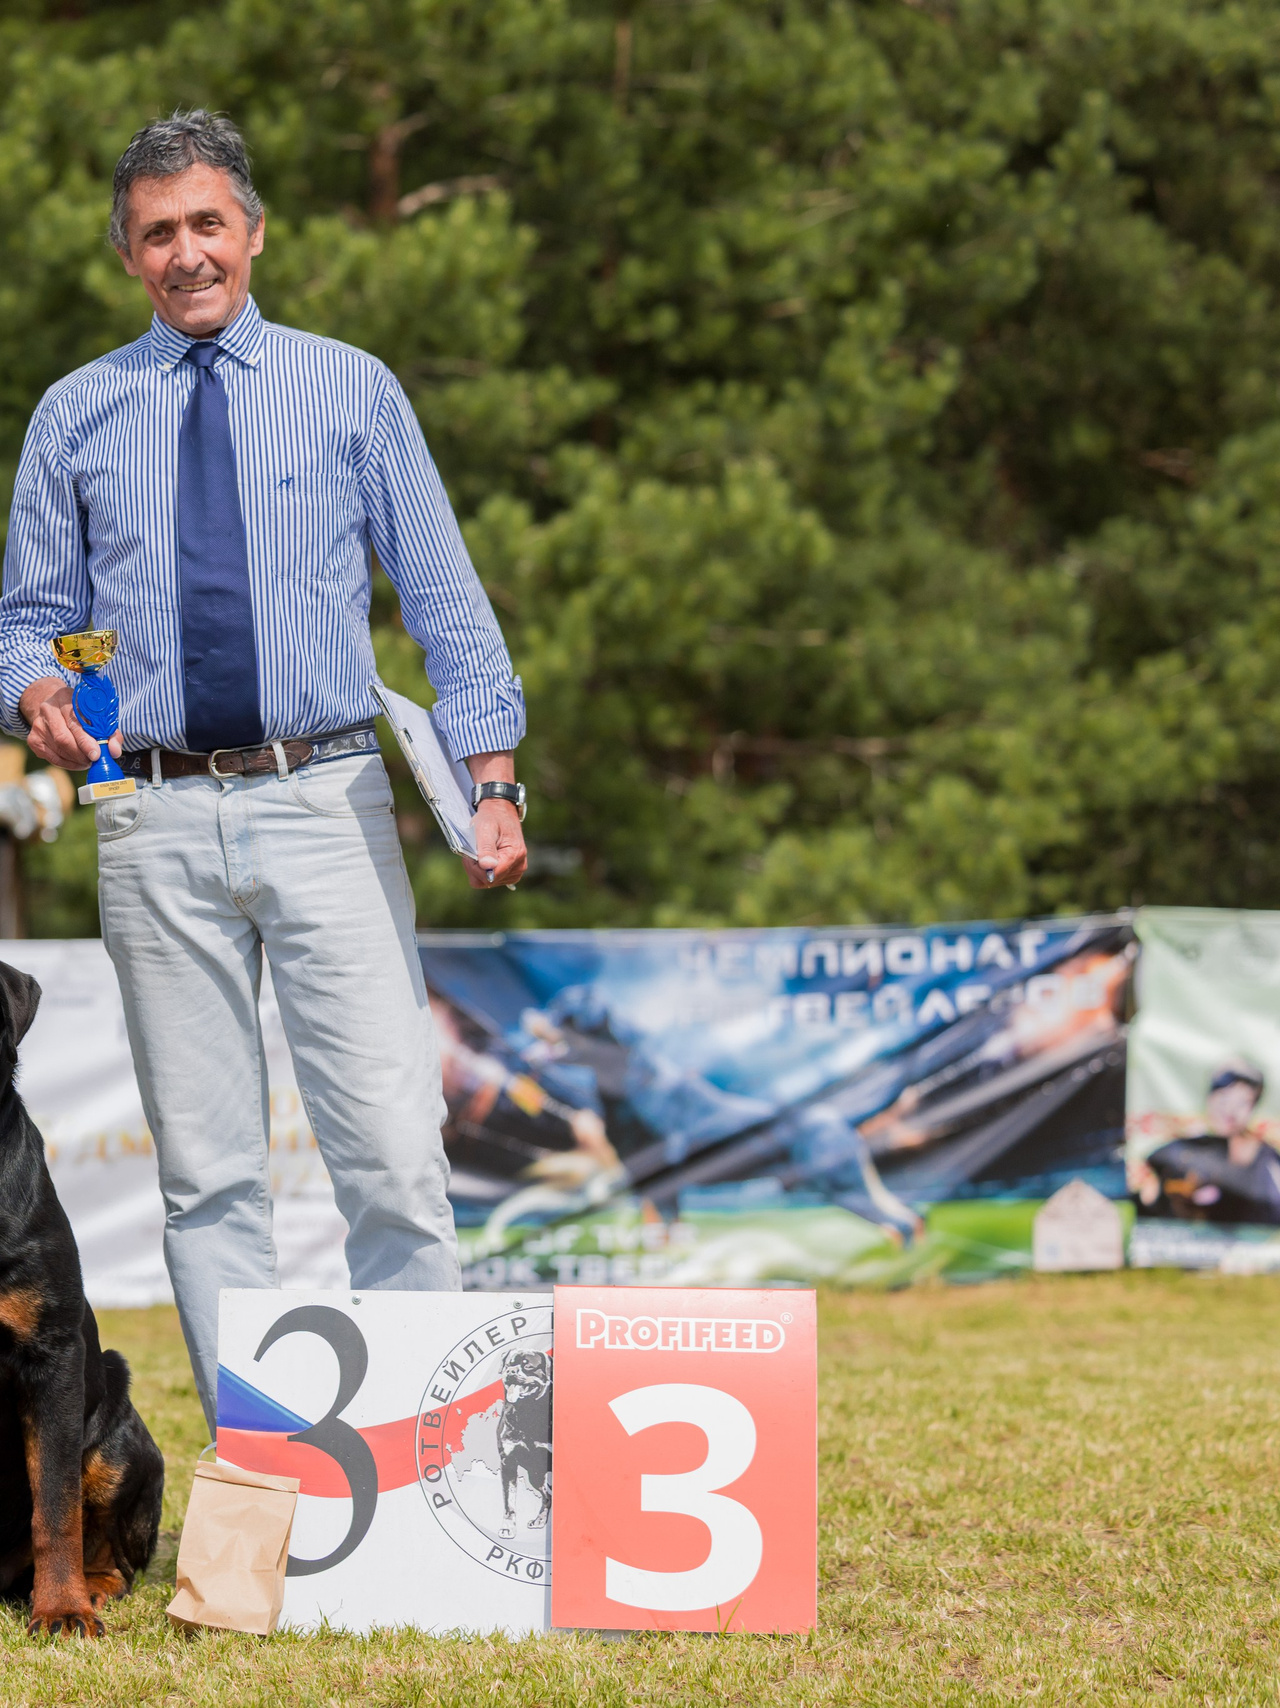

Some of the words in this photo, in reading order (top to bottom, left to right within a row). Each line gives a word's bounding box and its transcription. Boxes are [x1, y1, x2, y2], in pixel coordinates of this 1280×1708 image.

[420, 1315, 528, 1509] РОТВЕЙЛЕР
[576, 1309, 785, 1353] PROFIFEED
[253, 1304, 378, 1577] 3
[605, 1383, 763, 1611] 3
